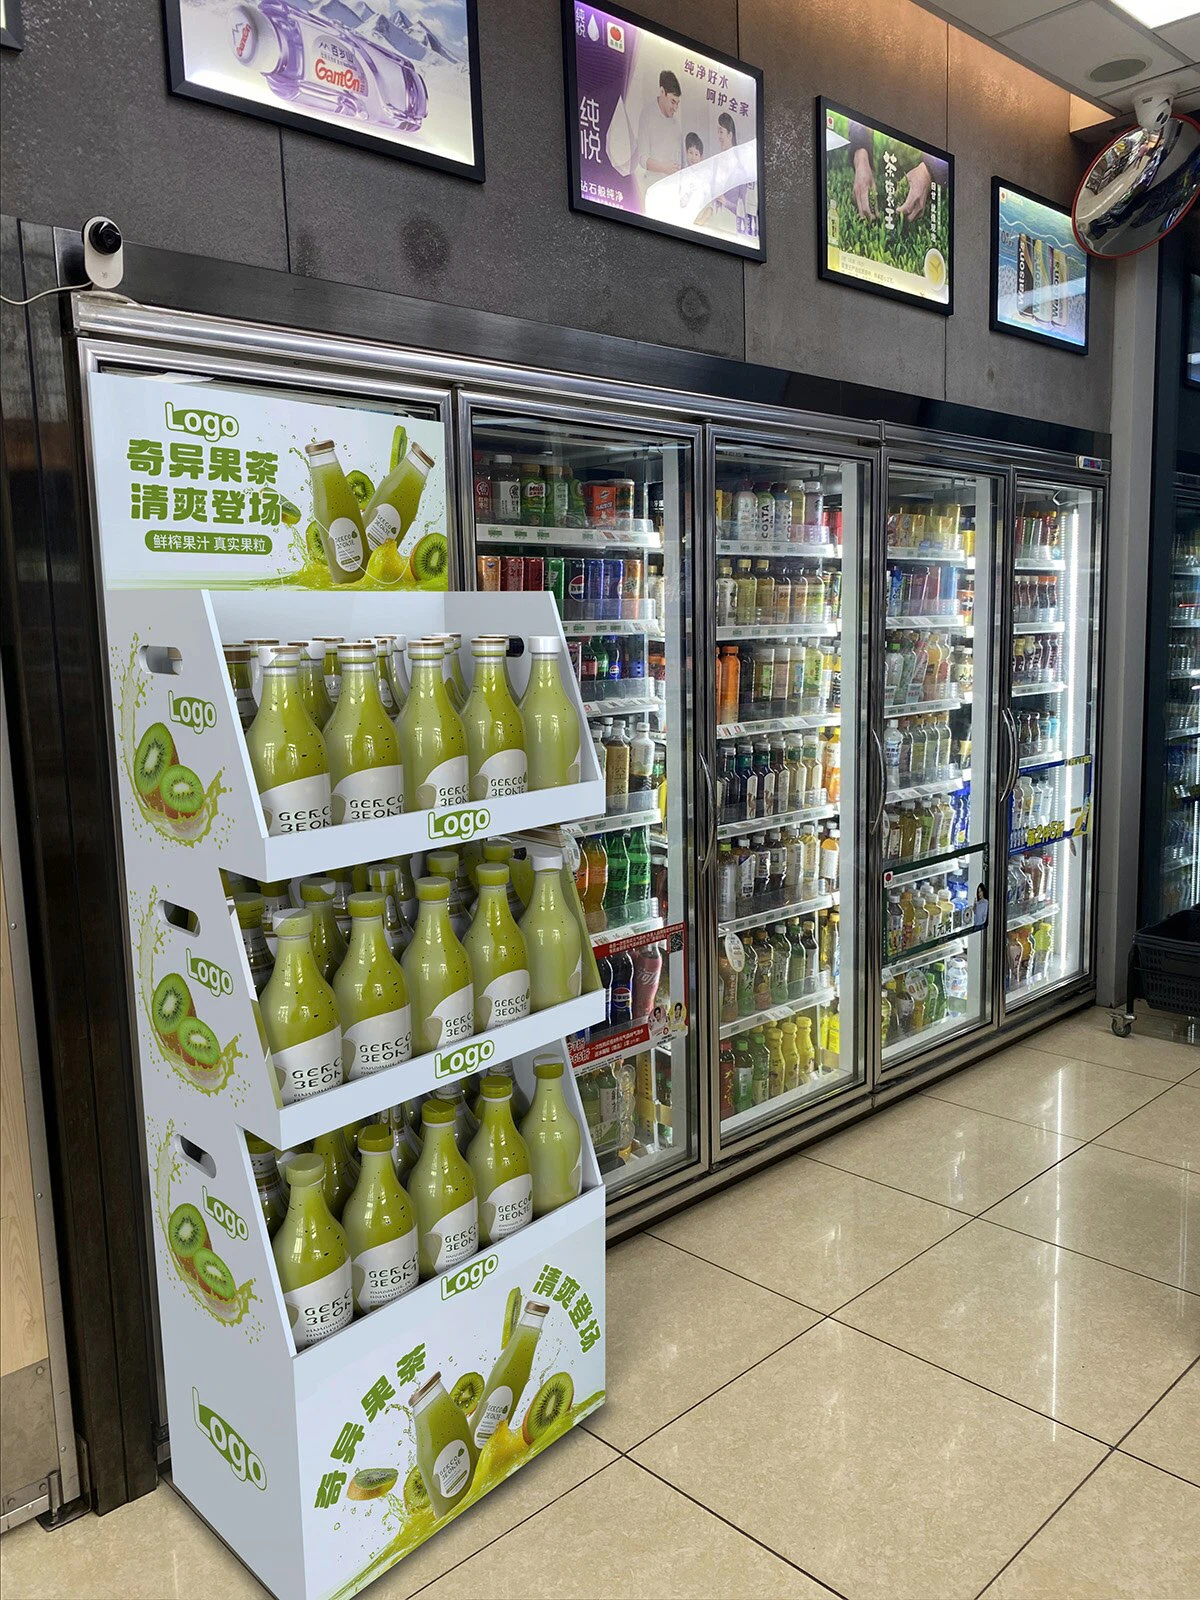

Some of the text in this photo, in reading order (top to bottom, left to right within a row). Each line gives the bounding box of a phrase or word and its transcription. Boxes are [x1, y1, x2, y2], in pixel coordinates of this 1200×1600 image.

[683, 59, 730, 89] 纯净好水
[706, 88, 750, 117] 呵护全家
[579, 96, 602, 164] 纯悦
[165, 402, 240, 442] Logo
[126, 438, 280, 486] 奇异果茶
[130, 482, 283, 527] 清爽登场
[153, 532, 267, 554] 鲜榨果汁 真实果粒
[168, 690, 218, 735] Logo
[428, 808, 491, 840] Logo
[186, 947, 234, 998] Logo
[434, 1039, 495, 1079] Logo
[201, 1185, 250, 1241] Logo
[440, 1253, 499, 1302] Logo
[531, 1264, 603, 1354] 清爽登场
[191, 1386, 268, 1491] Logo
[314, 1342, 427, 1510] 奇异果茶
